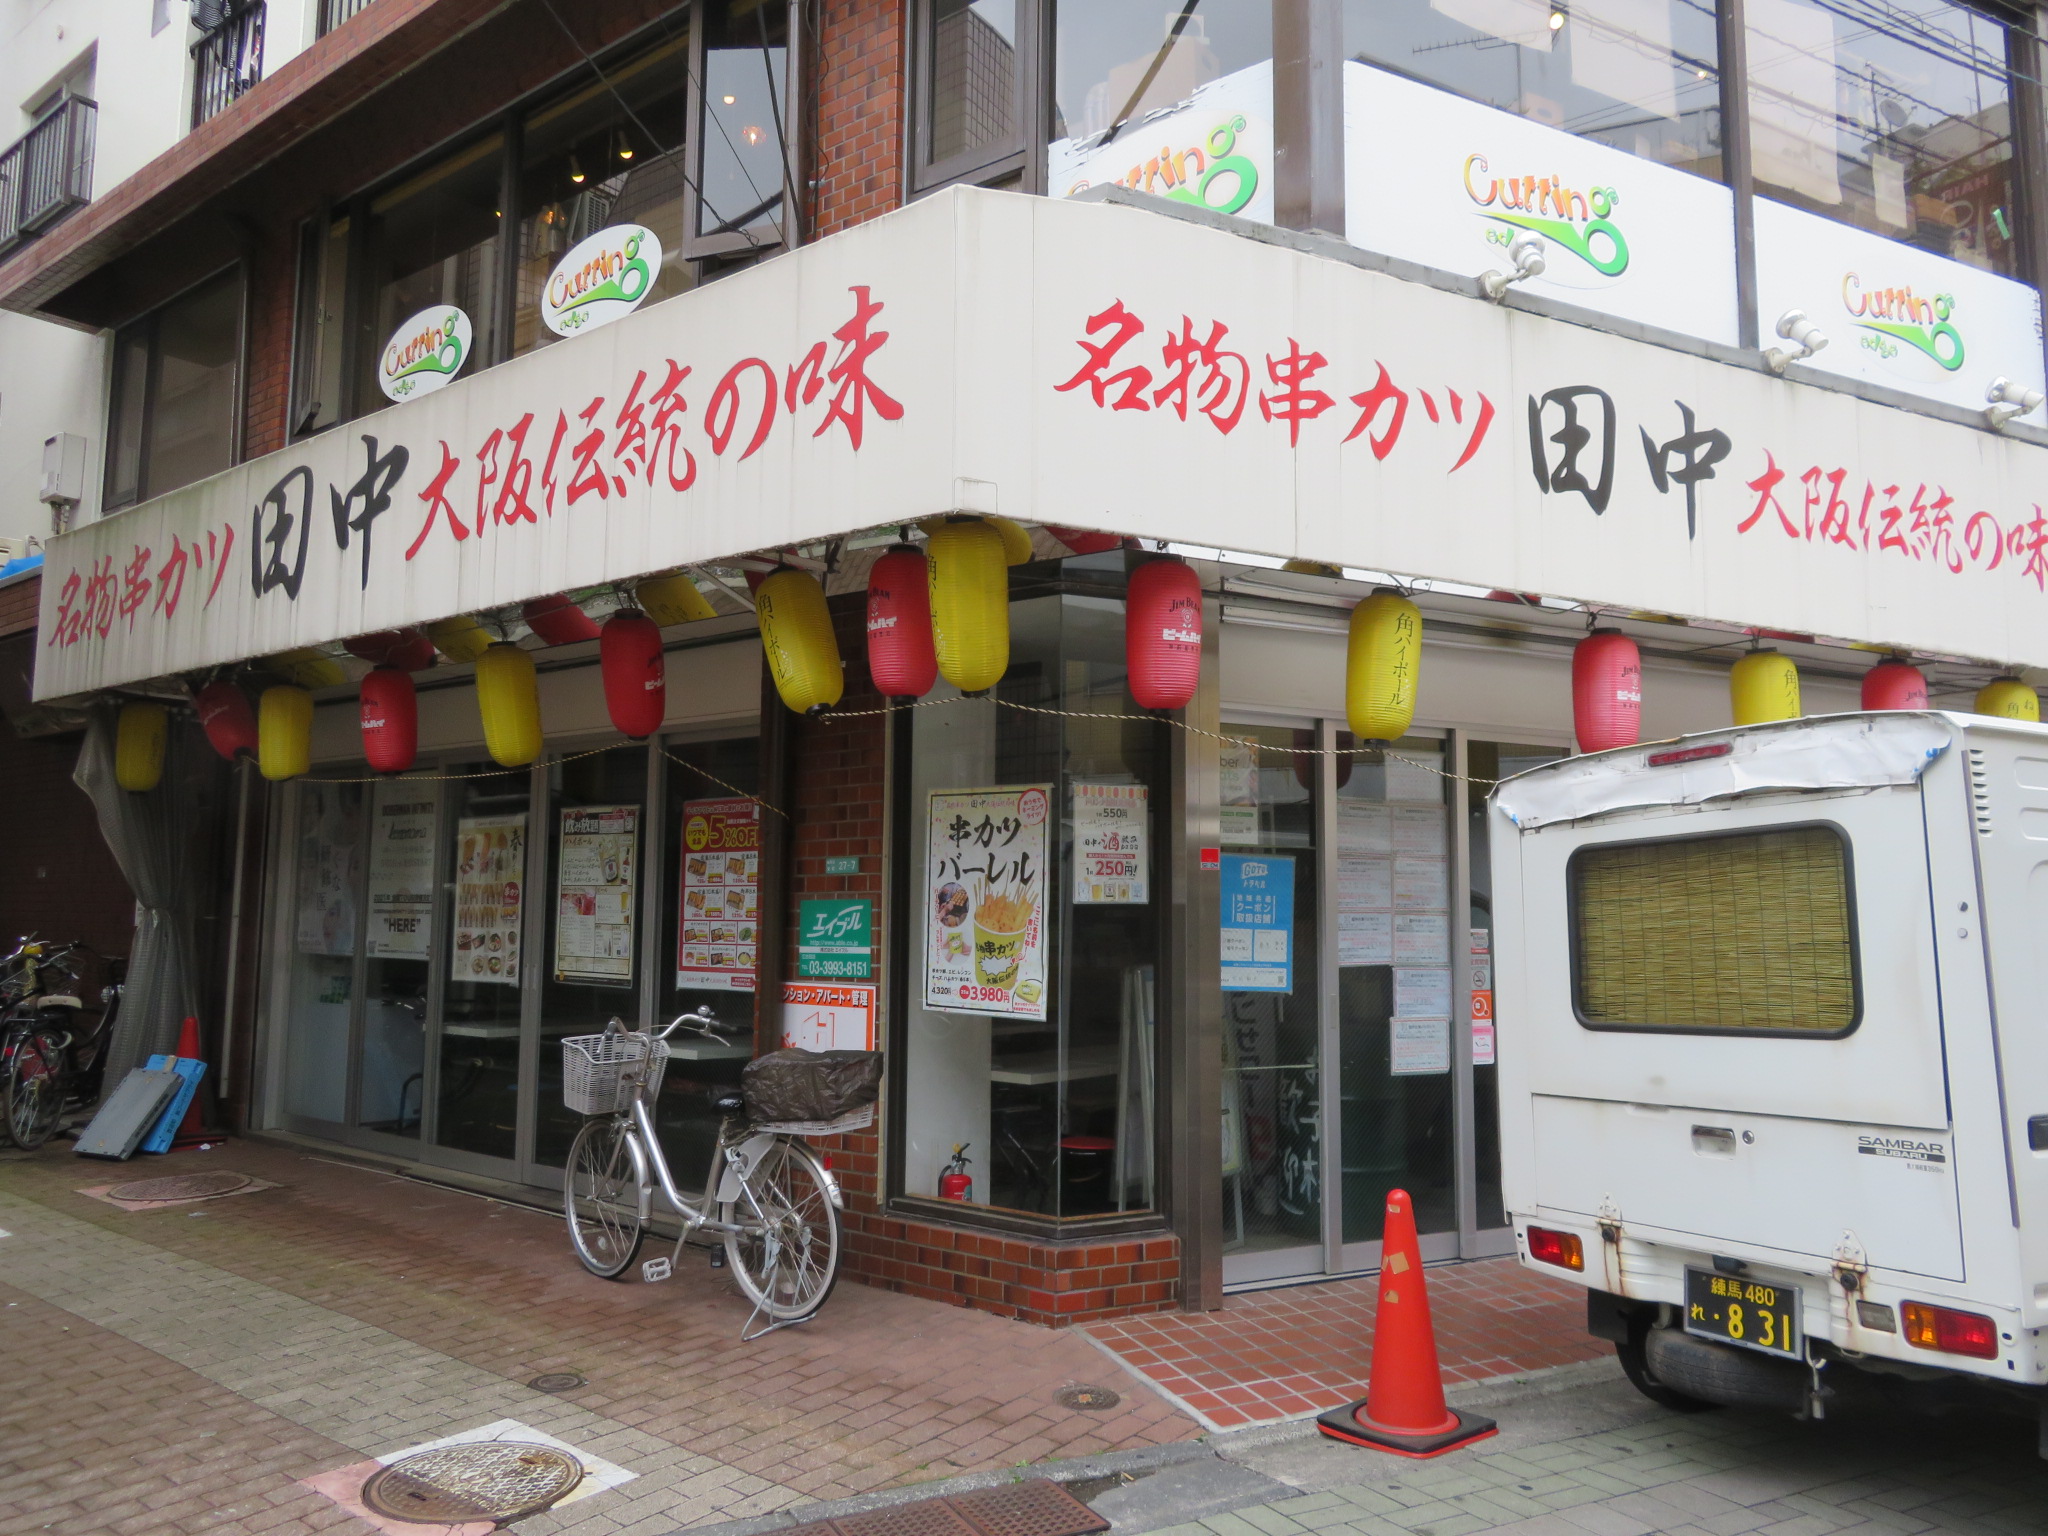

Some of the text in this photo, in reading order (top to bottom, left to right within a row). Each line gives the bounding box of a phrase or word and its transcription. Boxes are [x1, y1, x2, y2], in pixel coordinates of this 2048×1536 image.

[1053, 297, 1496, 474] 名物串カツ
[1527, 385, 1732, 540] 田中
[48, 285, 905, 649] 名物串カツ 田中 大阪伝統の味
[1220, 755, 1239, 767] ber
[948, 813, 1022, 849] 串カツ
[838, 861, 856, 871] 27-7
[937, 851, 1036, 886] バーレル
[1236, 902, 1271, 913] クーポン
[808, 907, 864, 938] エイブル
[1235, 913, 1272, 924] 取扱店舗
[809, 960, 867, 977] 03-3993-8151
[783, 987, 869, 1007] ンション・アパート・管理
[1858, 1136, 1944, 1154] SAMBAR
[1875, 1149, 1928, 1160] SUBARU
[1711, 1277, 1775, 1307] 練馬 480
[1690, 1302, 1706, 1321] れ
